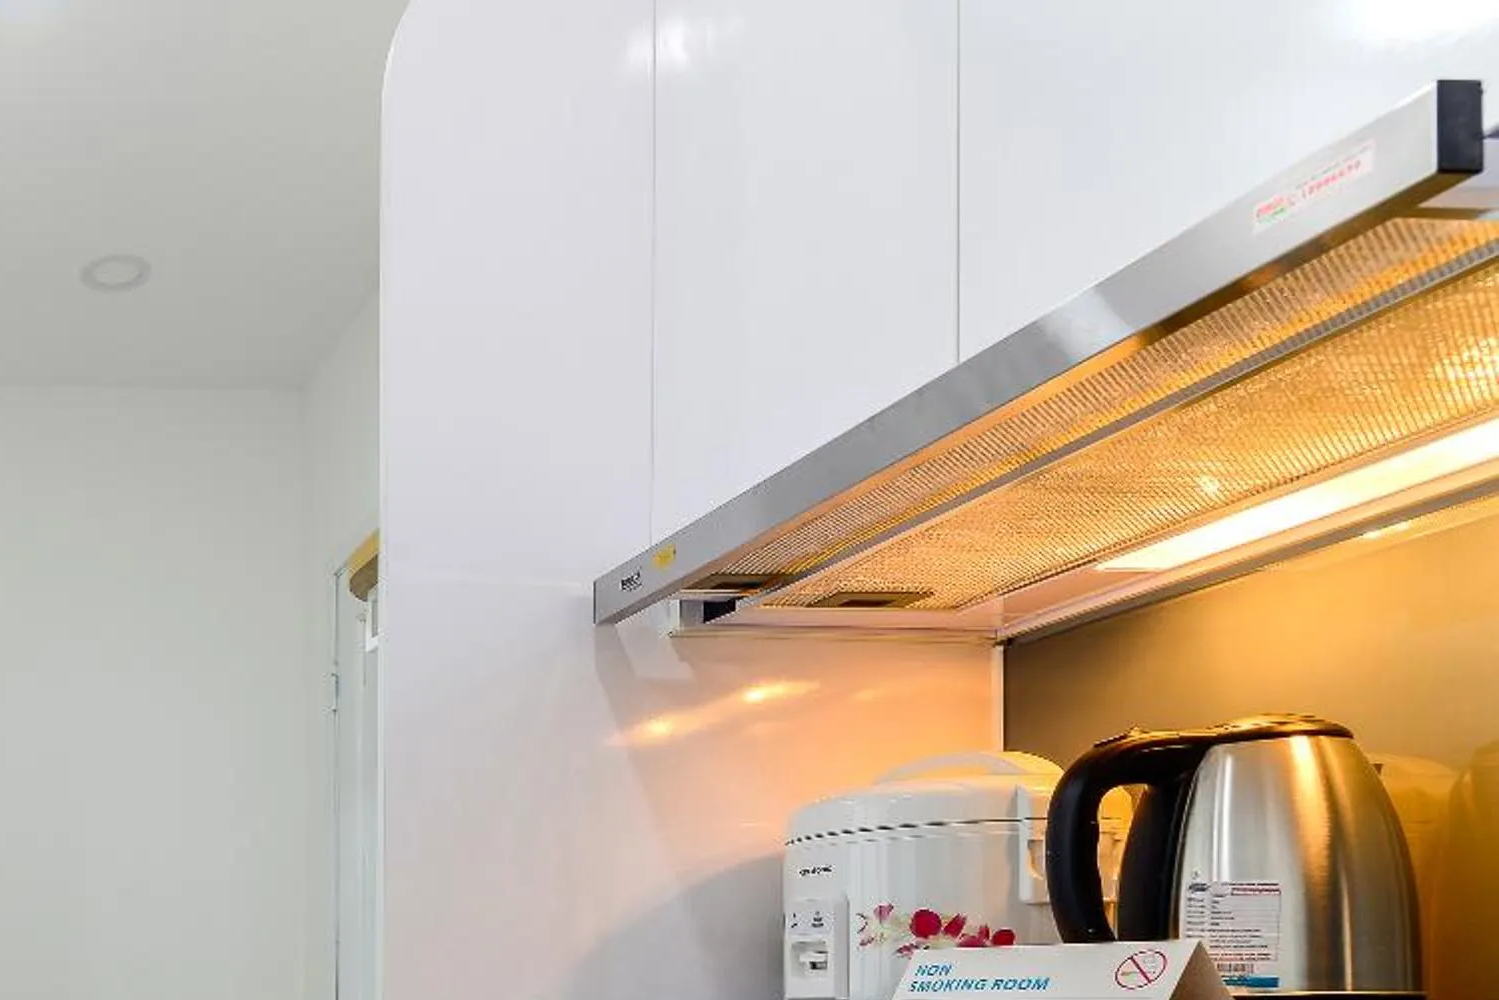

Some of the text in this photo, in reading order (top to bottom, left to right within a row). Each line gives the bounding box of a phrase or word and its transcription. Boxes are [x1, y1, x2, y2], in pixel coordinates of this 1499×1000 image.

[914, 963, 953, 977] NON
[909, 976, 1051, 993] SMOKING ROOM
